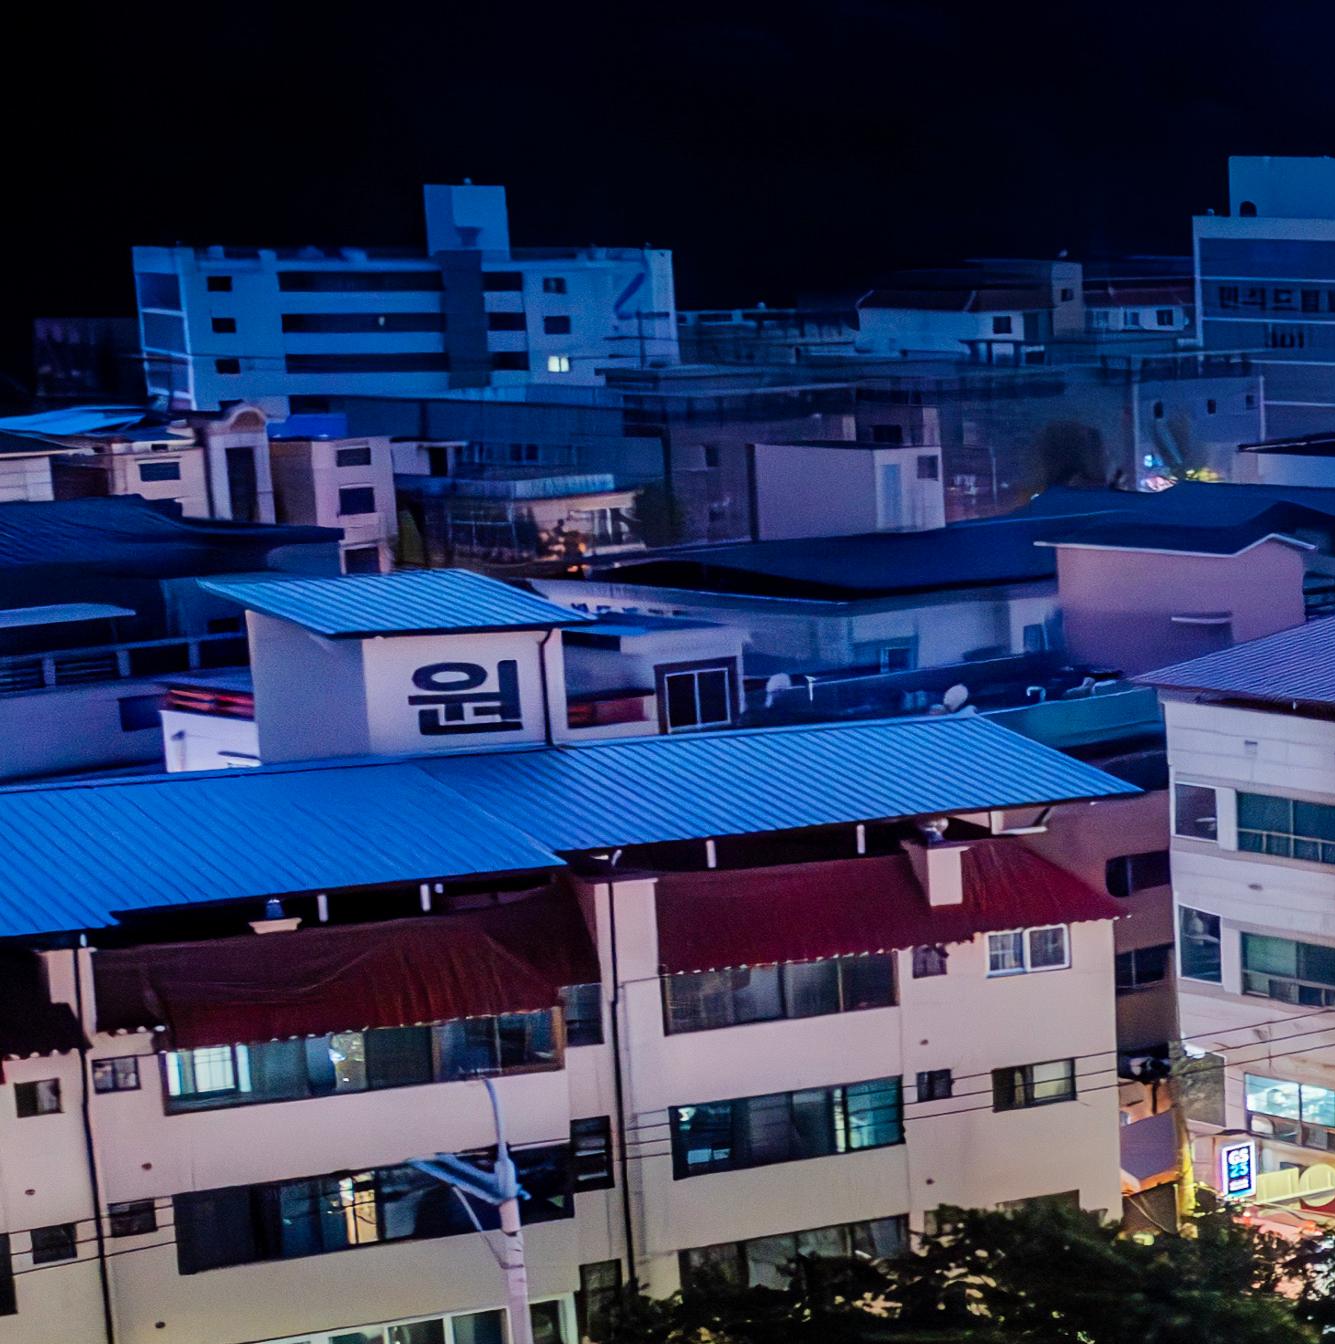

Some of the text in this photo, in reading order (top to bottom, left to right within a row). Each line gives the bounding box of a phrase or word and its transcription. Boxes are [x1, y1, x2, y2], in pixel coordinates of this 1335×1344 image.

[408, 659, 524, 736] 원
[1228, 1147, 1250, 1165] GS
[1229, 1163, 1249, 1178] 25
